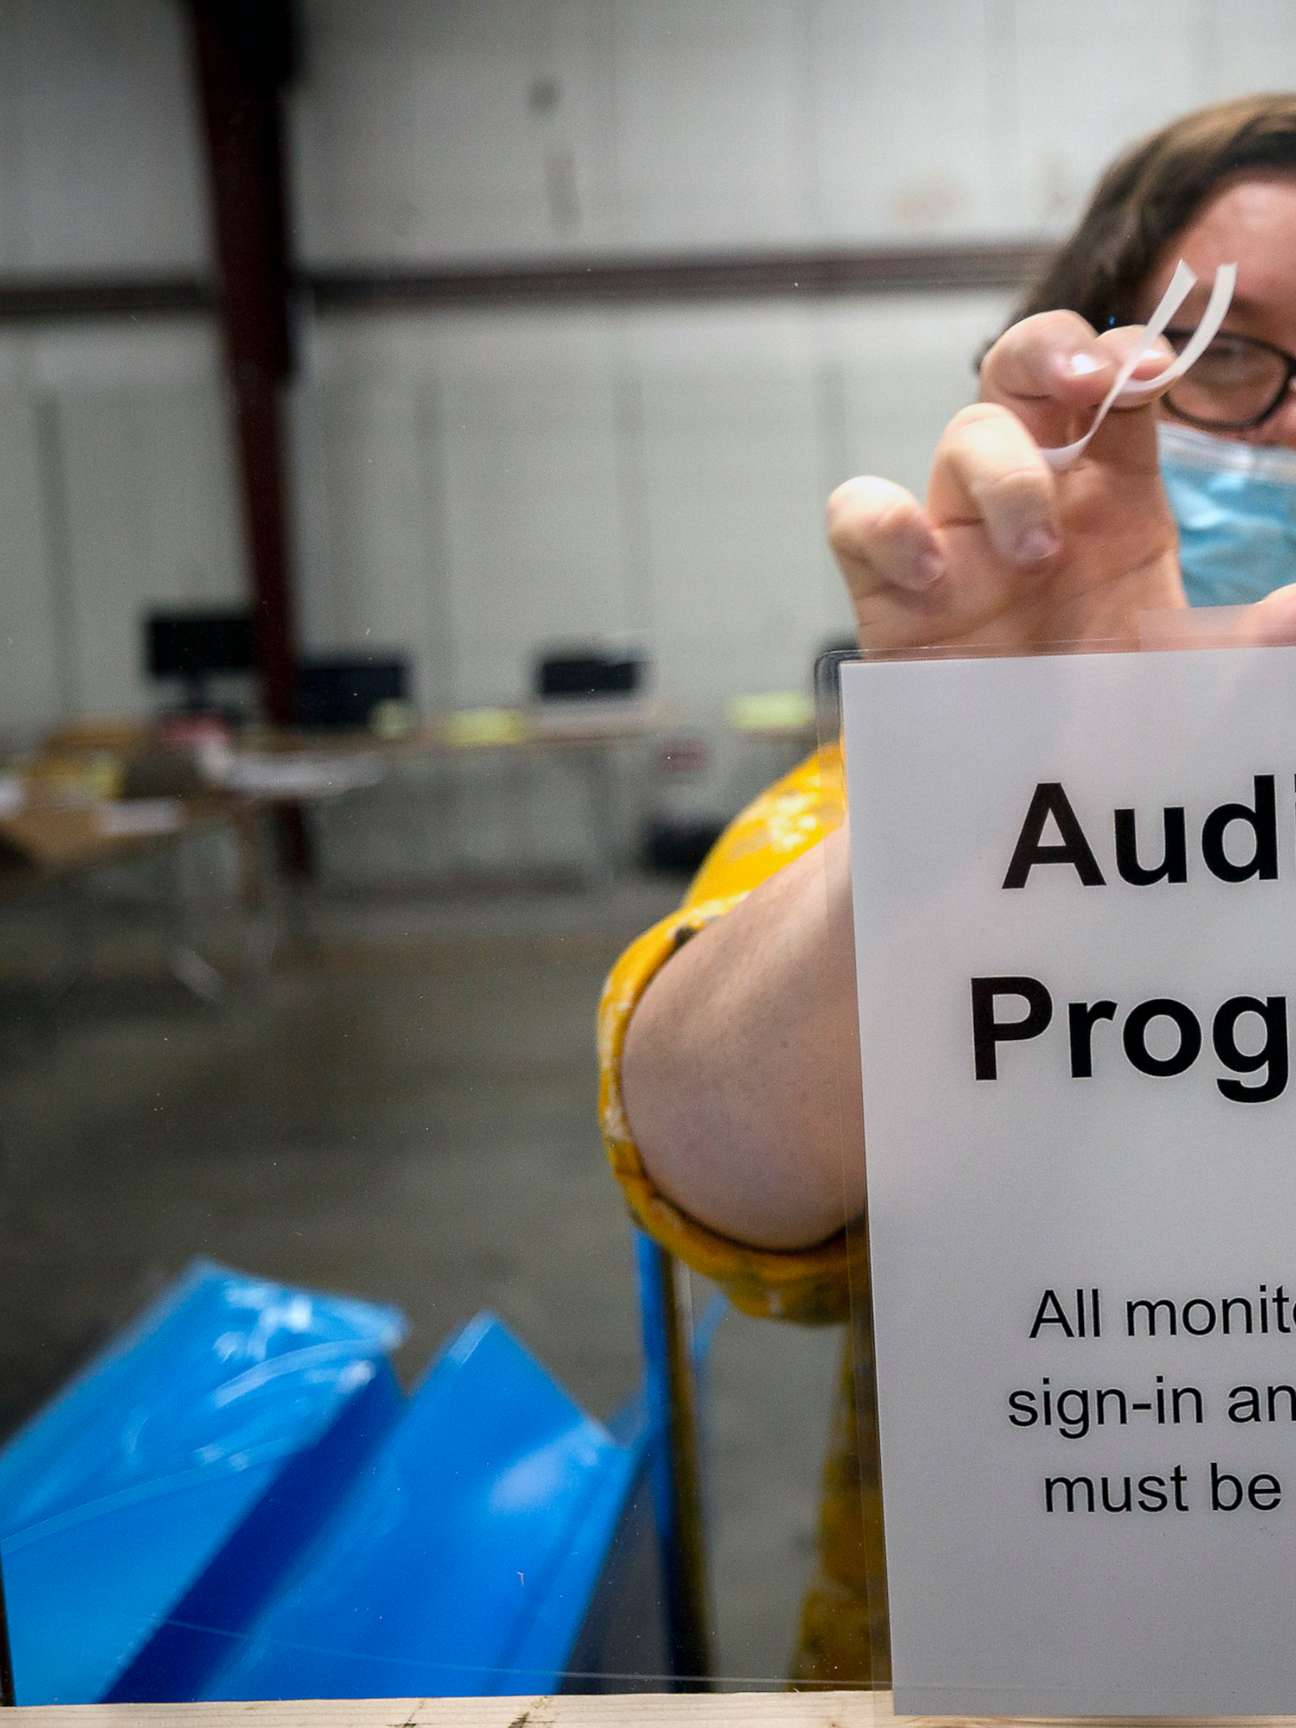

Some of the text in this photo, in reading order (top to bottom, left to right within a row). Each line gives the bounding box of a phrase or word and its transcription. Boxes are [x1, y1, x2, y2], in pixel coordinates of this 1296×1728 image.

[1029, 1289, 1100, 1338] All
[1009, 1376, 1203, 1439] sign-in
[1045, 1465, 1189, 1512] must
[1210, 1463, 1281, 1511] be
